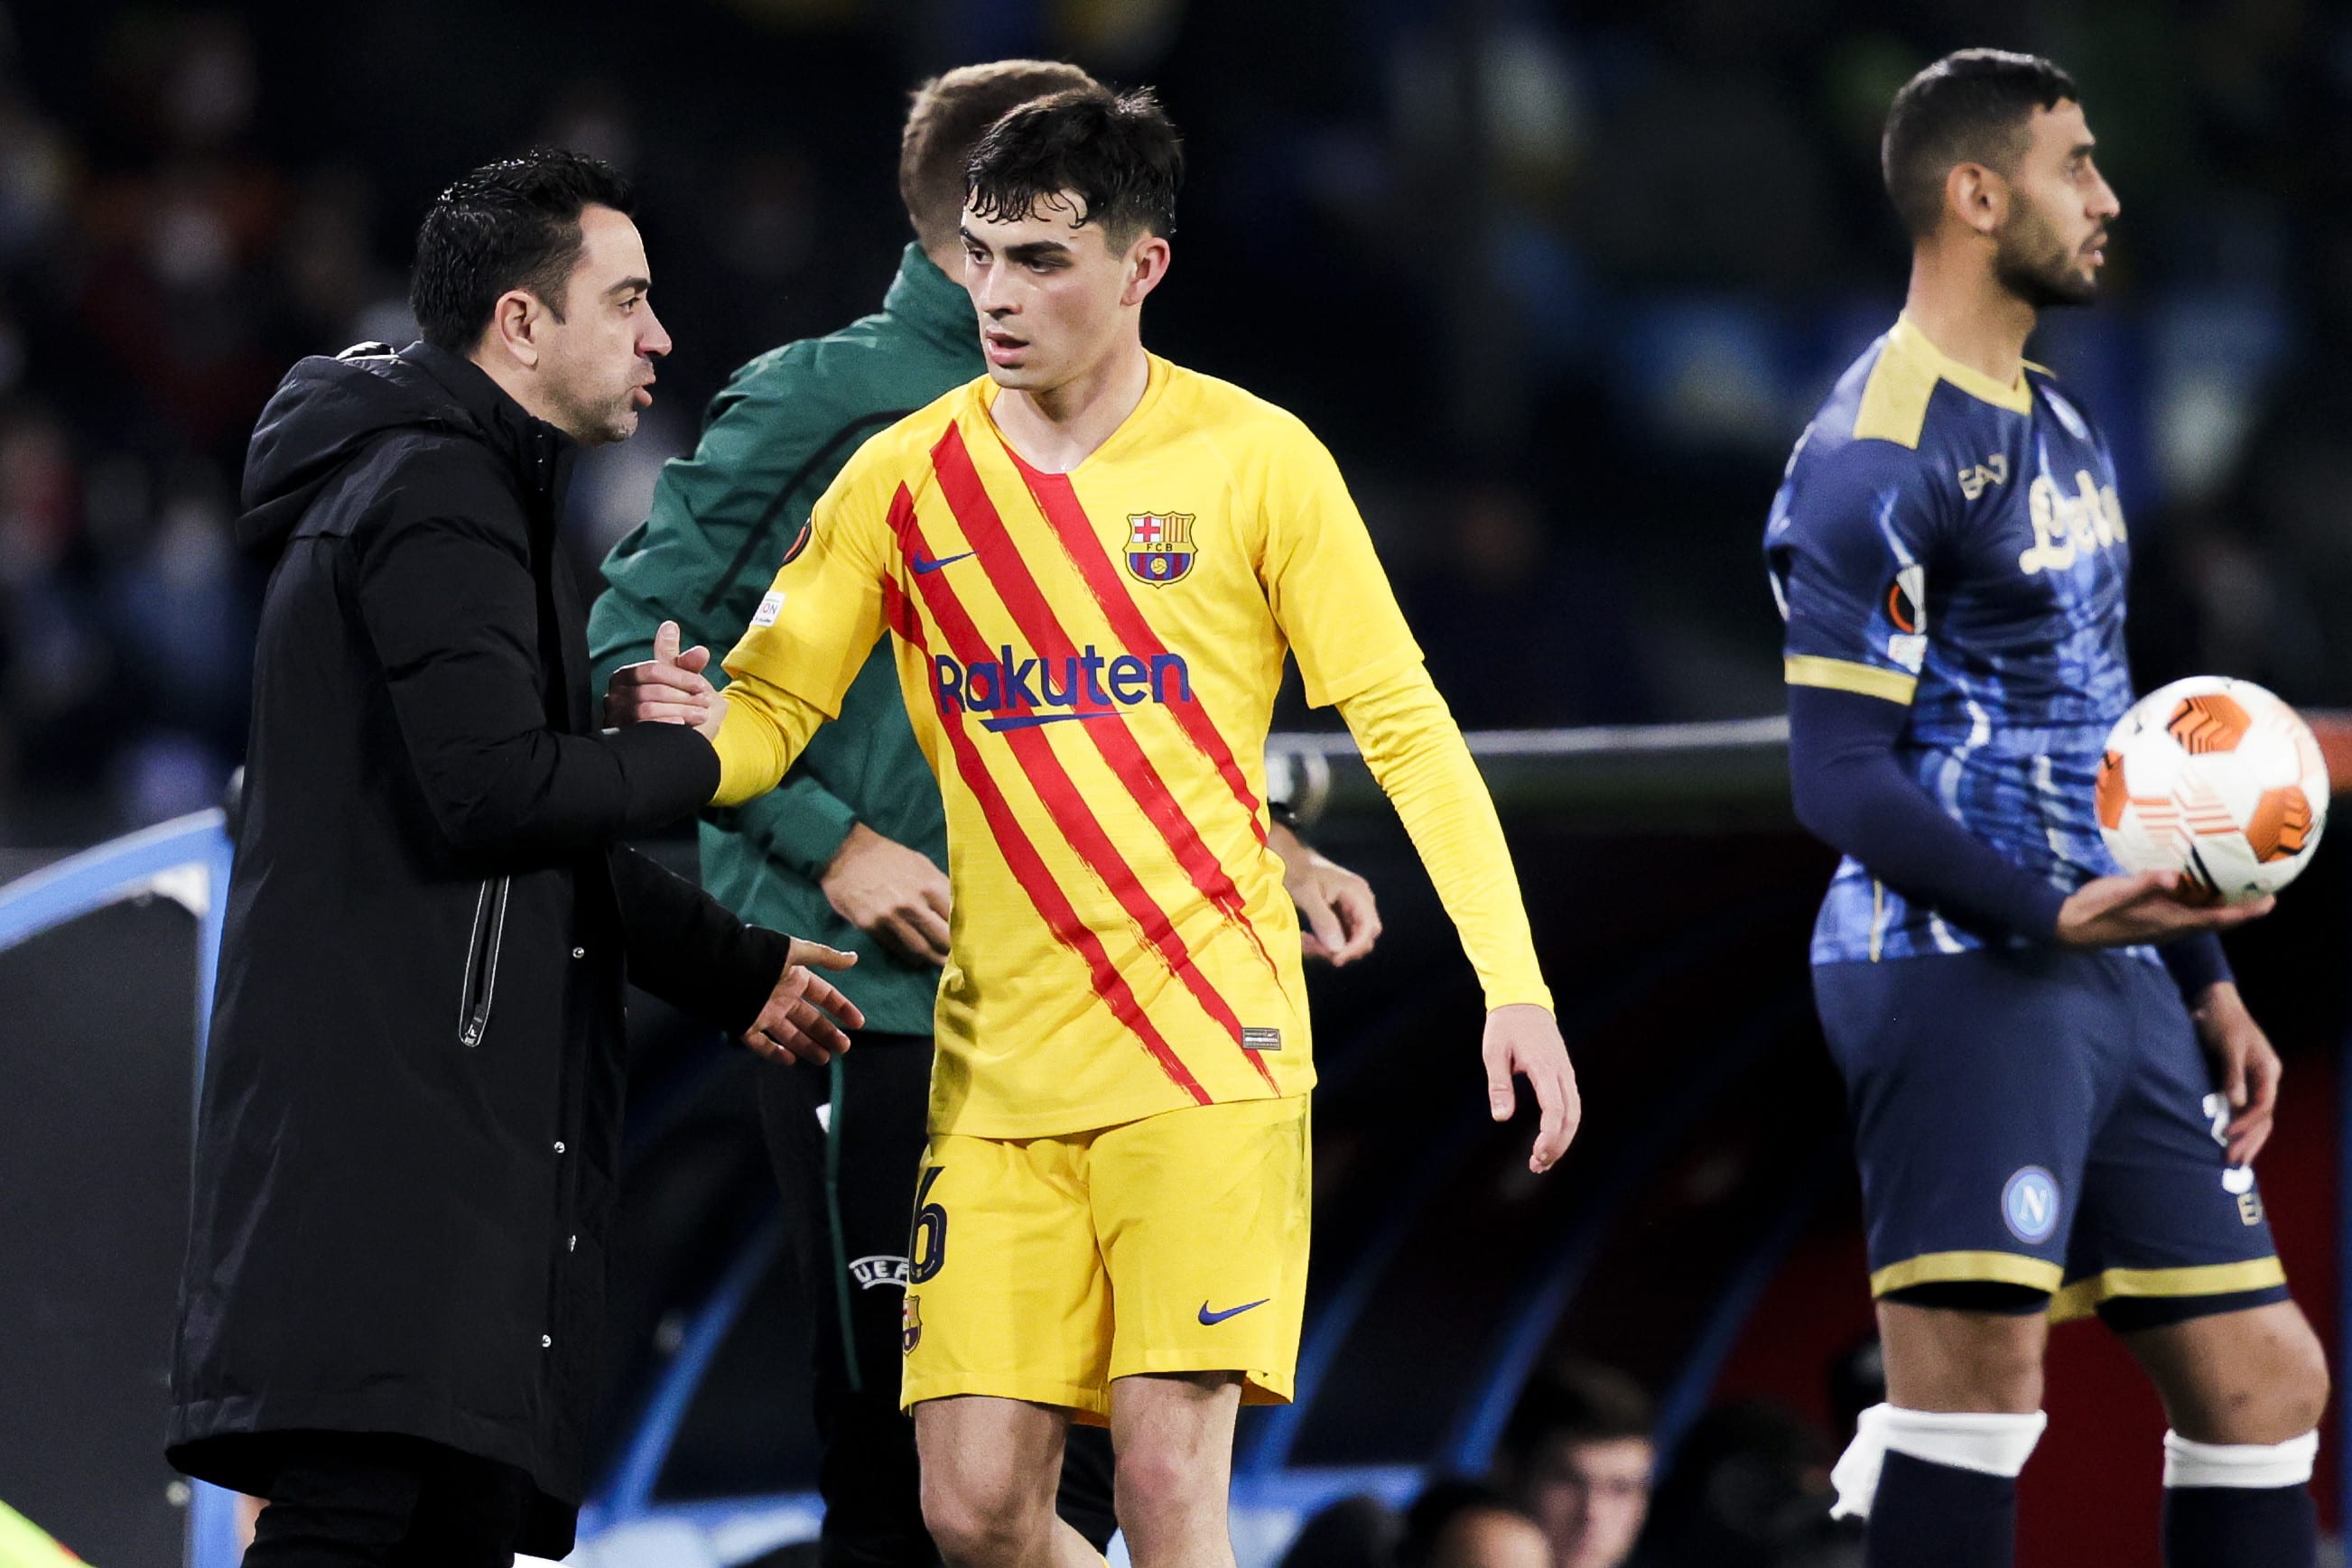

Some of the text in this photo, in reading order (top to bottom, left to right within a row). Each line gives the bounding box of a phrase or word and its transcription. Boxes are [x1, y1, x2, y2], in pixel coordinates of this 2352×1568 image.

[1147, 543, 1173, 552] FCB
[934, 645, 1191, 714] Rakuten
[2019, 1184, 2049, 1222] N
[908, 1166, 948, 1285] 6
[853, 1260, 909, 1283] UEF
